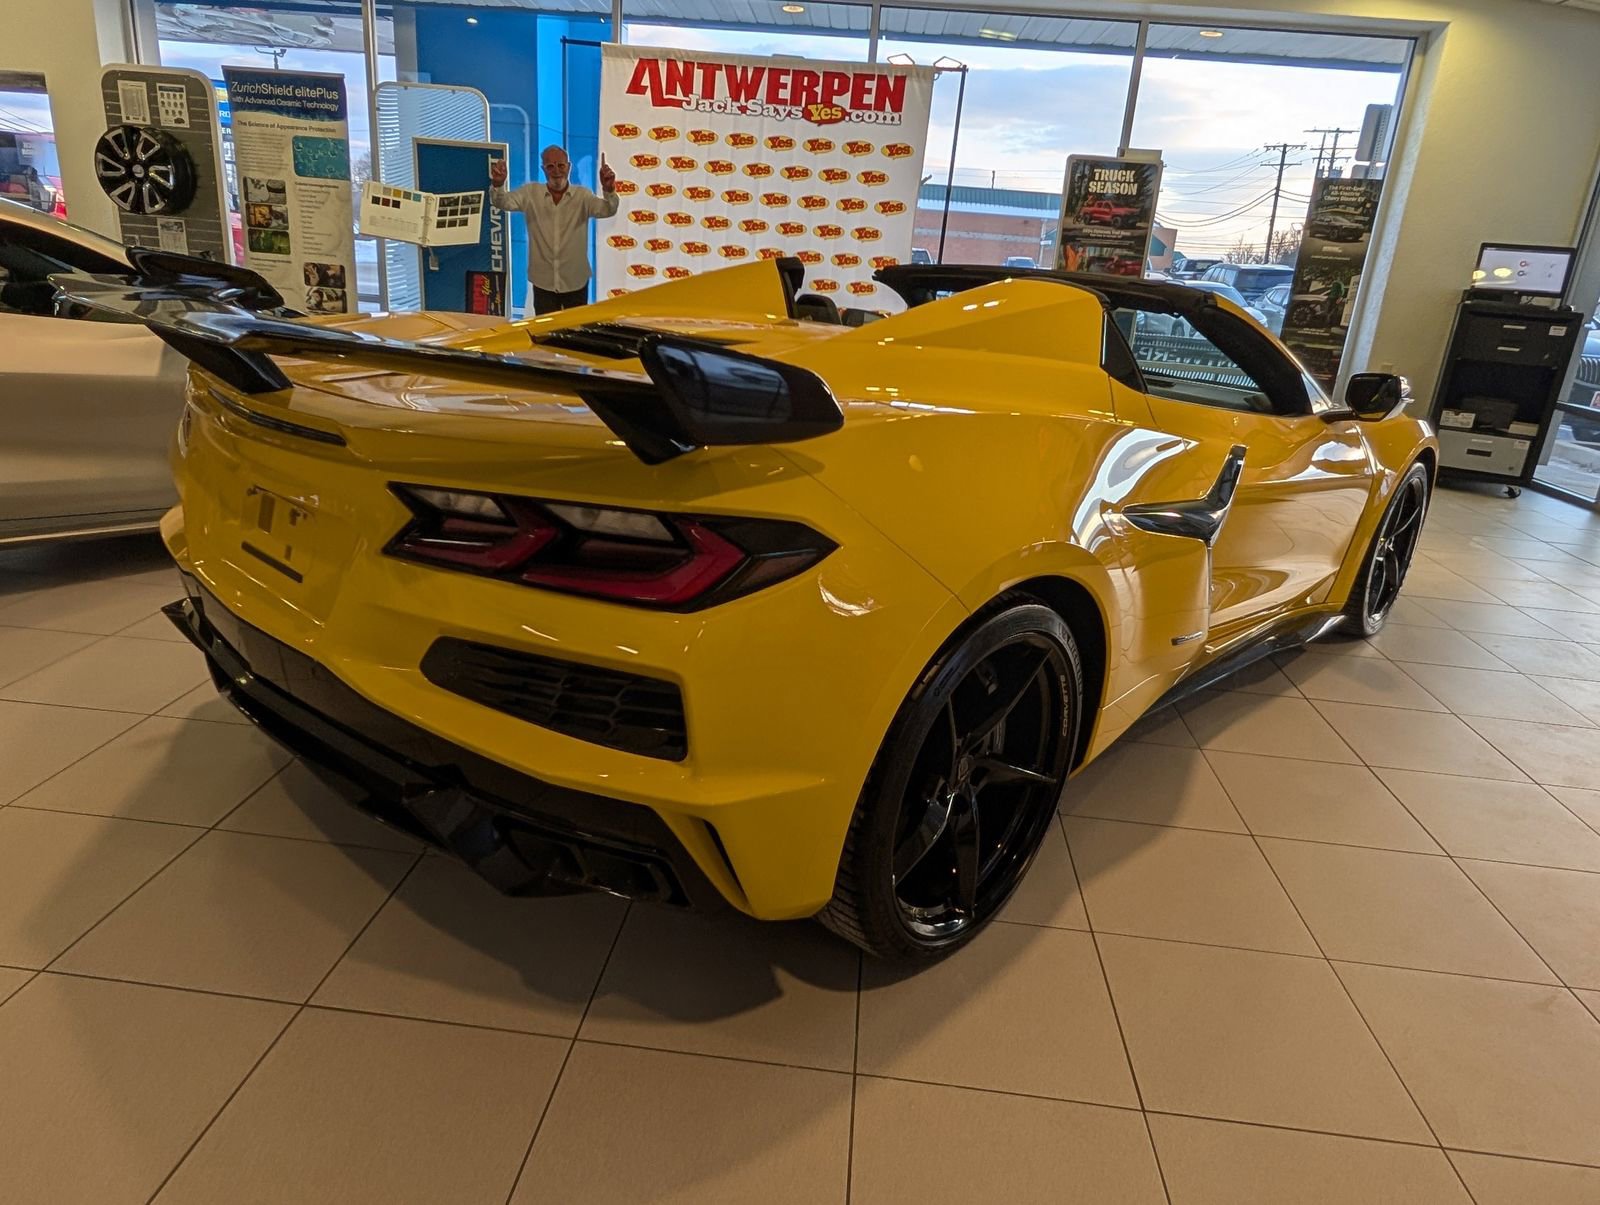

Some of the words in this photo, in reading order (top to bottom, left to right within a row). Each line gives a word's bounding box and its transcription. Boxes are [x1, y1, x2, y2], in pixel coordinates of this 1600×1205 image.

[295, 87, 339, 101] elitePlus
[626, 57, 907, 113] ANTWERPEN
[245, 96, 275, 106] Advanced
[276, 98, 302, 108] Ceramic
[303, 101, 338, 112] Technology
[614, 124, 638, 136] Yes
[653, 127, 676, 140] Yes
[691, 130, 715, 143] Yes
[730, 133, 754, 146] Yes
[768, 136, 793, 148] Yes
[808, 138, 832, 151] Yes
[847, 141, 871, 154] Yes
[887, 143, 911, 156] Yes
[634, 154, 657, 167] Yes
[670, 156, 694, 169] Yes
[709, 160, 732, 173] Yes
[747, 164, 770, 176] Yes
[786, 166, 809, 178] Yes
[823, 168, 847, 181] Yes
[861, 171, 885, 184] Yes
[1094, 168, 1136, 183] TRUCK
[650, 183, 672, 196] Yes
[687, 186, 711, 199] Yes
[725, 190, 749, 202] Yes
[764, 193, 787, 205] Yes
[802, 196, 826, 208] Yes
[841, 198, 864, 211] Yes
[880, 201, 903, 213] Yes
[1088, 181, 1138, 196] SEASON
[489, 153, 503, 272] CHEVRT
[632, 210, 655, 222] Yes
[668, 212, 691, 224] Yes
[705, 216, 728, 228] Yes
[743, 219, 766, 231] Yes
[780, 222, 803, 234] Yes
[818, 224, 841, 237] Yes
[855, 227, 879, 239] Yes
[611, 235, 634, 247] Yes
[648, 238, 670, 251] Yes
[684, 241, 708, 254] Yes
[722, 245, 745, 257] Yes
[835, 254, 858, 265] Yes
[631, 264, 654, 276] Yes
[814, 279, 836, 291] Yes
[851, 281, 873, 293] Yes
